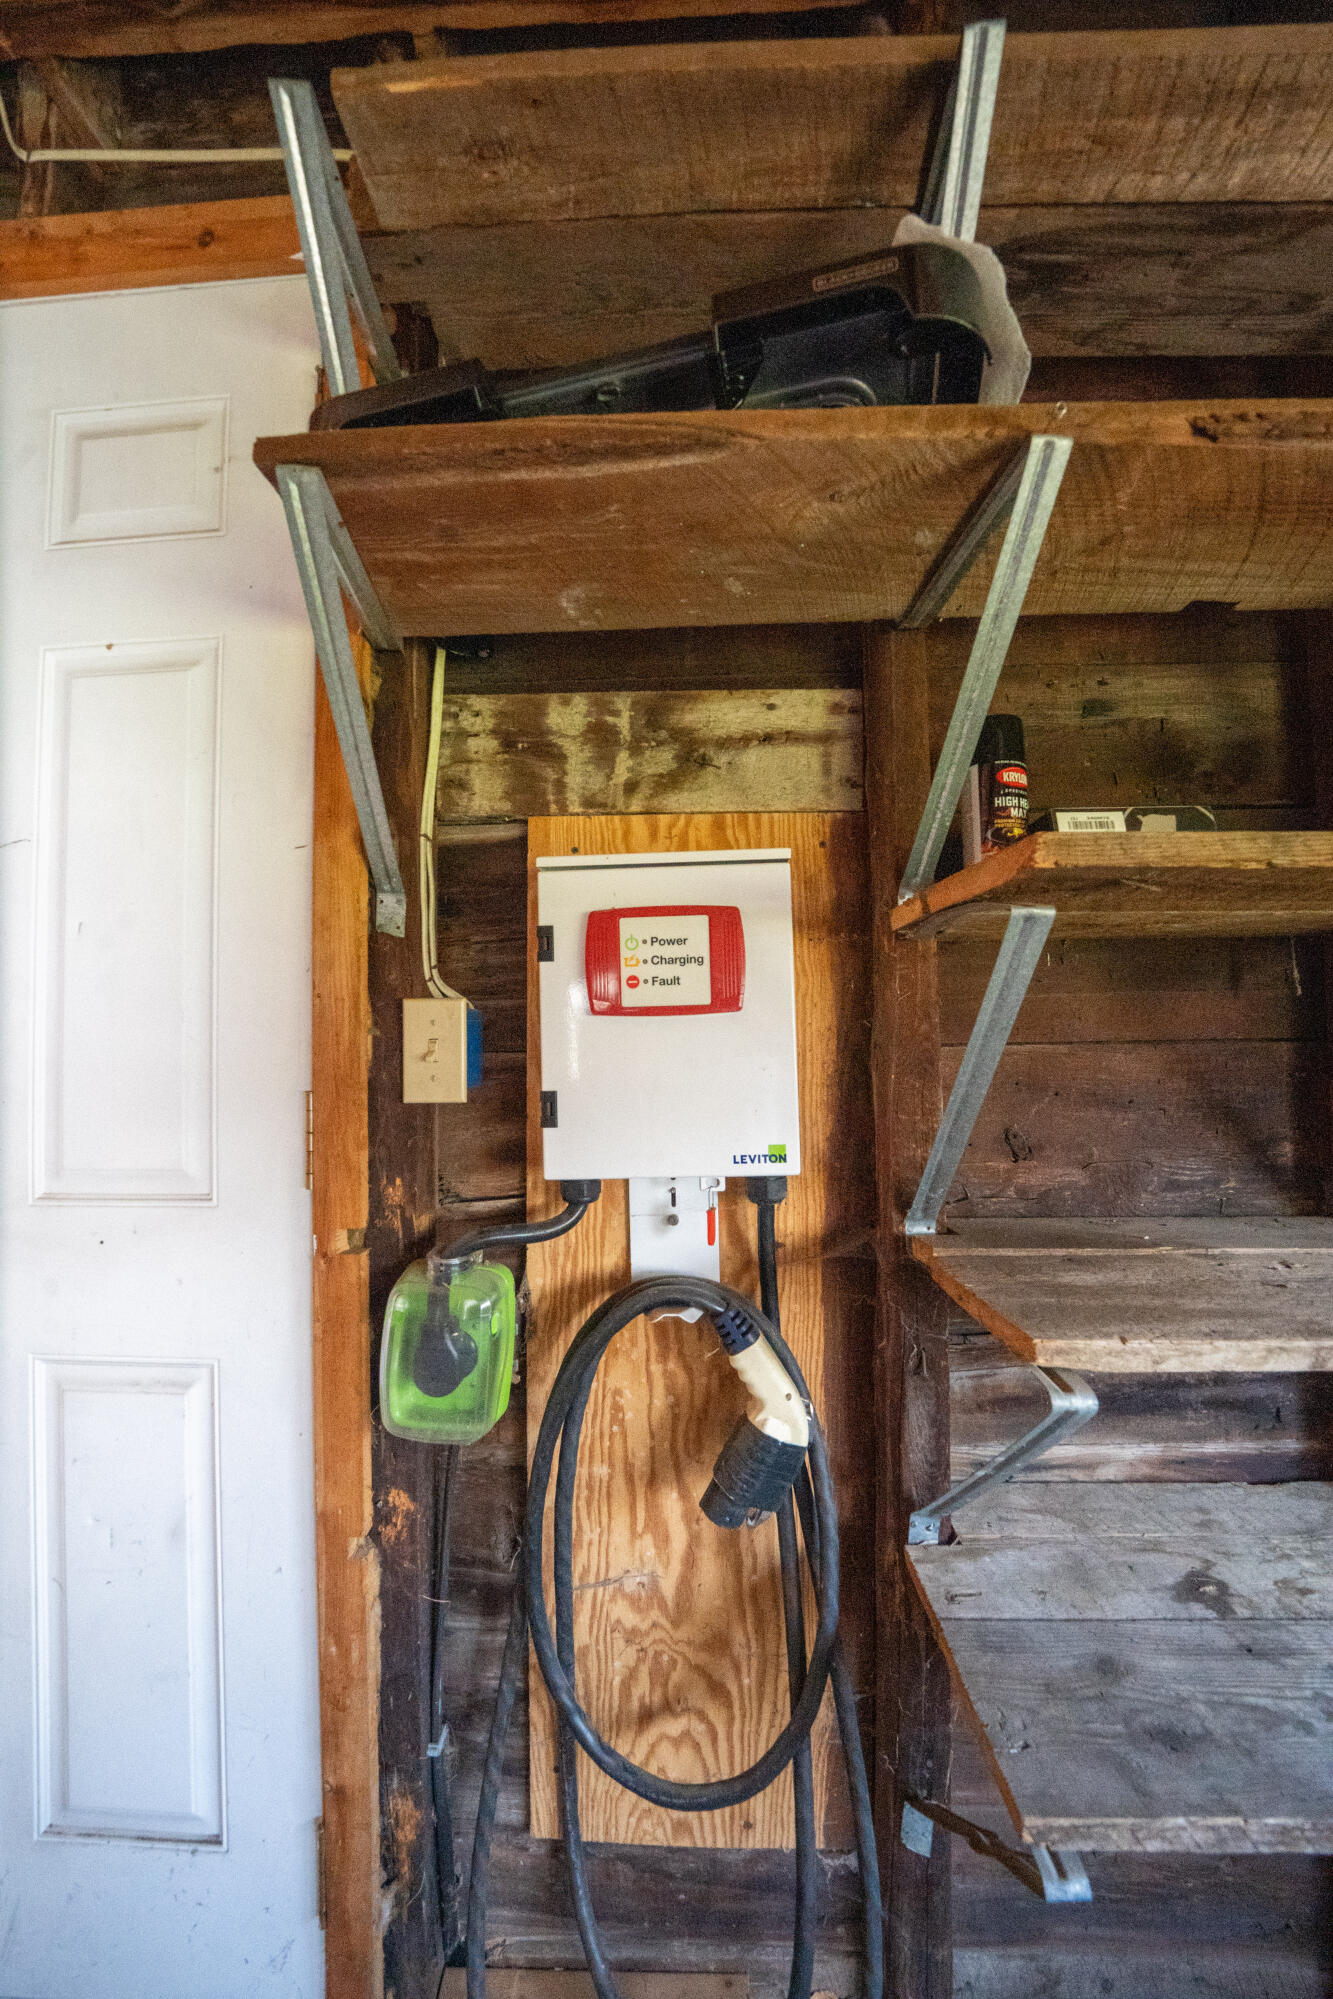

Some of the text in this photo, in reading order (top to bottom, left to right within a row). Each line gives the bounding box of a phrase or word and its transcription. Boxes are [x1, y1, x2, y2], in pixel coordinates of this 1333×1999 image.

[994, 796, 1019, 808] HIGH
[650, 936, 689, 947] Power
[650, 954, 705, 967] Charging
[651, 975, 681, 987] Fault
[732, 1153, 788, 1165] LEVITON
